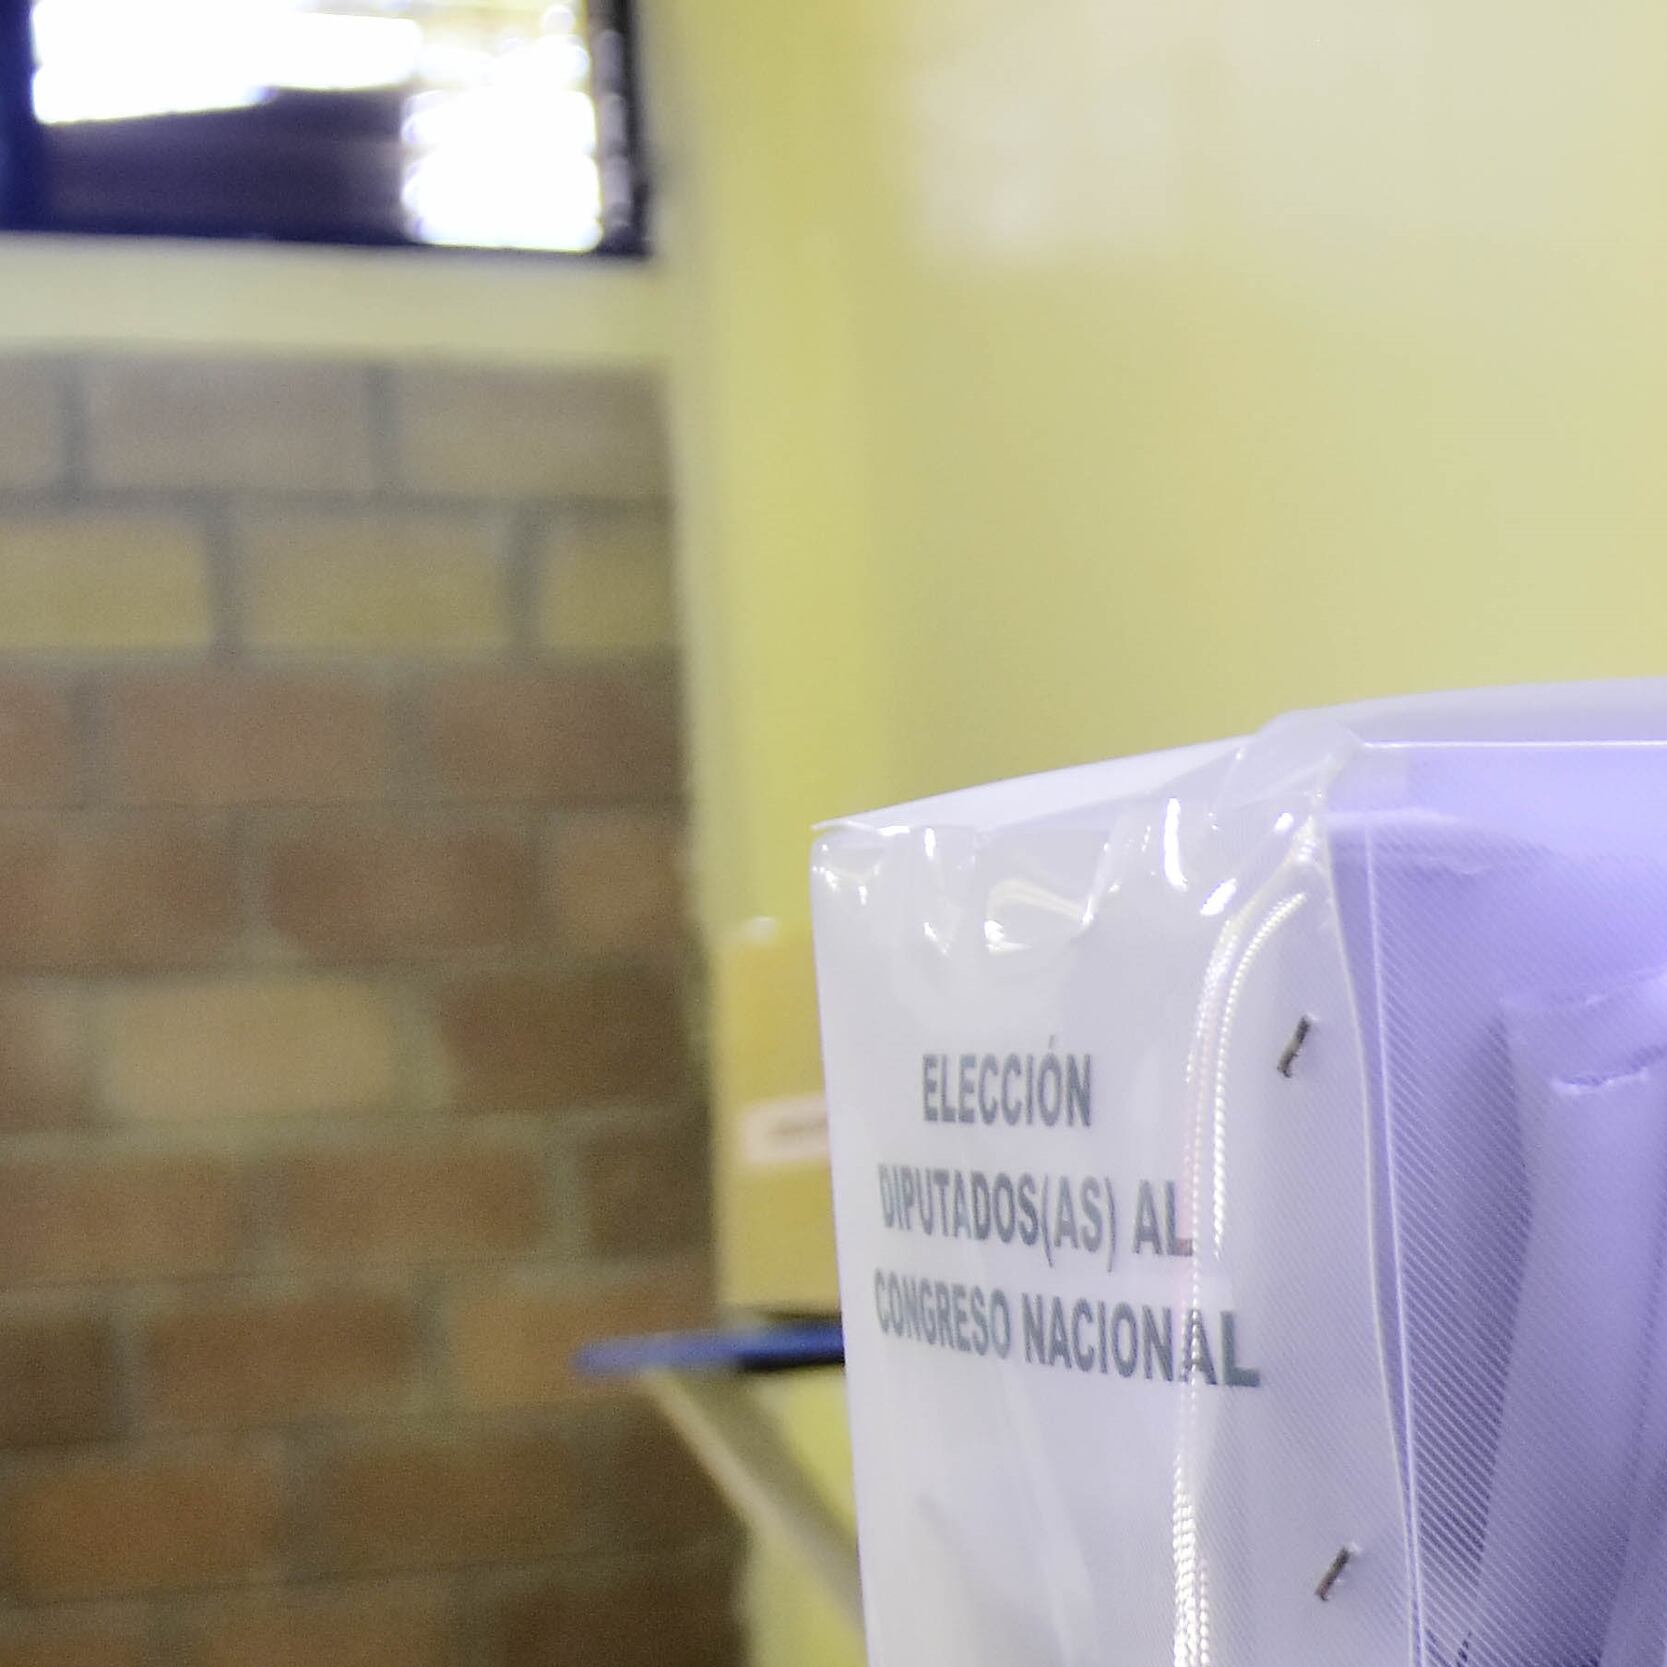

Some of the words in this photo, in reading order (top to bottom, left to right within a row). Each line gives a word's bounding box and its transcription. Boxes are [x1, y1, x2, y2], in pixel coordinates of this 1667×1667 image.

[922, 1034, 1093, 1128] ELECCIÓN
[877, 1163, 1118, 1273] DIPUTADOS(AS)
[1132, 1179, 1194, 1257] AL
[874, 1267, 1011, 1360] CONGRESO
[1020, 1291, 1261, 1389] NACIONAL
